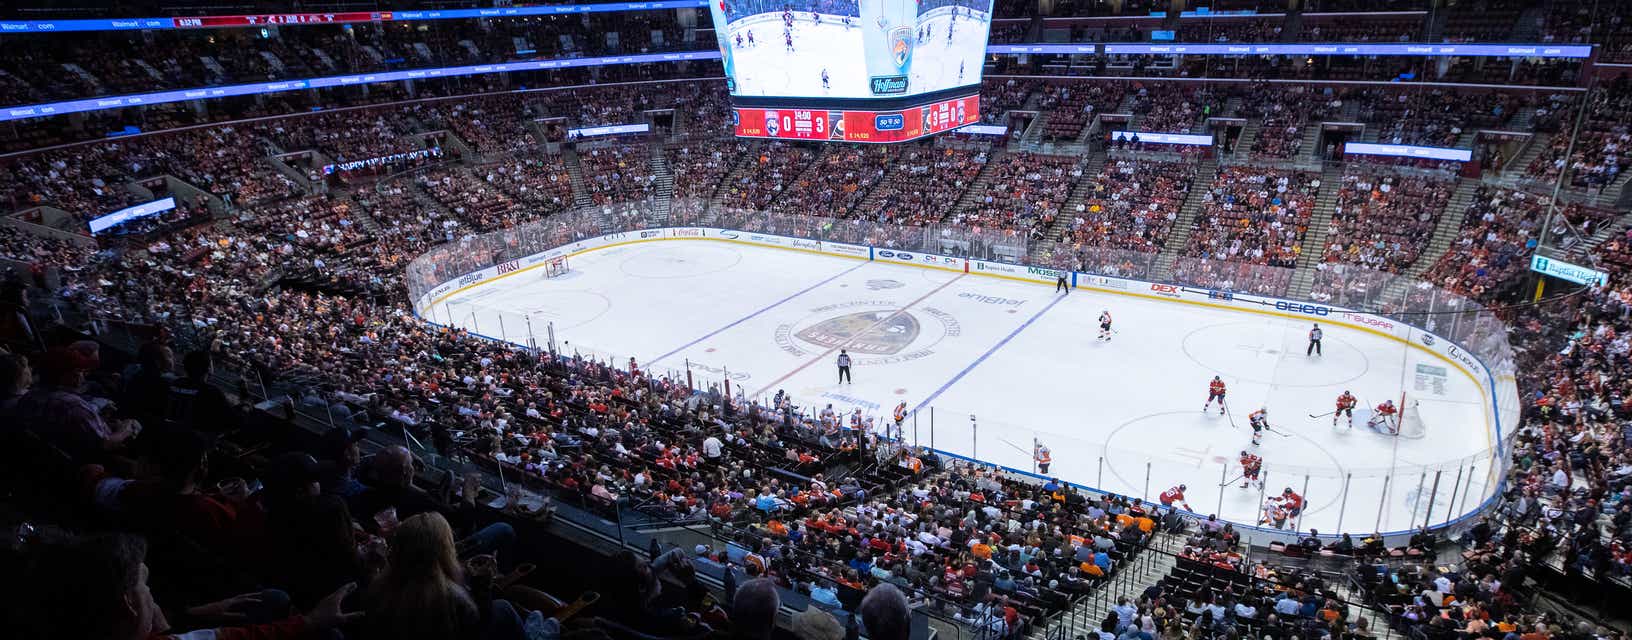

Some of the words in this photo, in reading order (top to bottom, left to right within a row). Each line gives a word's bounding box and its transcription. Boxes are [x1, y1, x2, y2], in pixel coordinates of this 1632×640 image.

[0, 23, 28, 31] Walmart
[932, 111, 938, 126] 3
[951, 107, 956, 121] 0
[784, 116, 791, 131] 0
[815, 116, 823, 132] 3
[1150, 284, 1178, 294] DEX
[1275, 301, 1329, 316] GEICO
